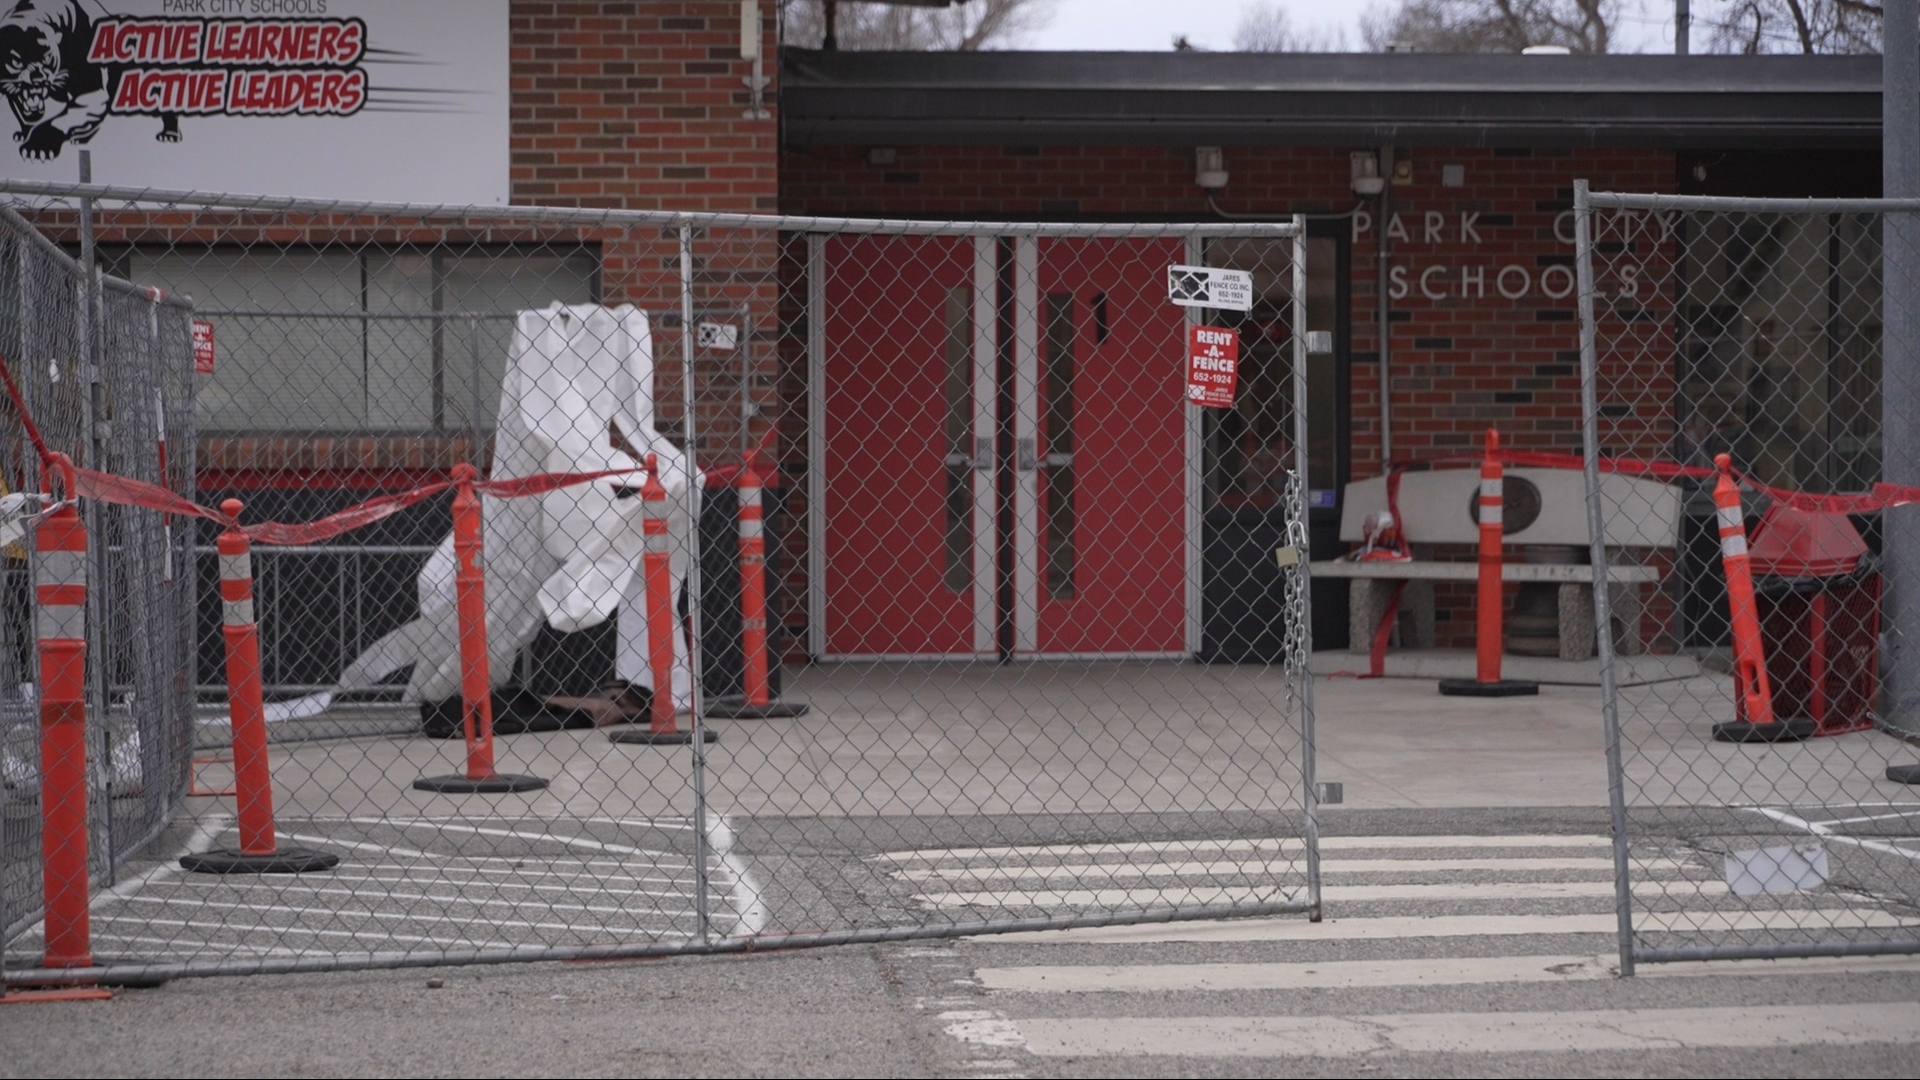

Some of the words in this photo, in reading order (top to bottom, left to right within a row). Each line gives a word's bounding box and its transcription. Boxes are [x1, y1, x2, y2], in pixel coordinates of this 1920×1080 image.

[163, 0, 206, 13] PARK
[210, 0, 245, 13] CITY
[250, 0, 328, 14] SCHOOLS
[89, 22, 202, 62] ACTIVE
[203, 22, 361, 63] LEARNERS
[113, 69, 227, 110] ACTIVE
[228, 69, 363, 112] LEADERS
[1352, 211, 1482, 244] PARK
[1553, 209, 1677, 244] CITY
[1210, 281, 1229, 290] FENCE
[1222, 274, 1241, 283] JARES
[1218, 290, 1244, 299] 652-1924
[1197, 330, 1232, 346] RENT
[1204, 345, 1224, 358] -A-
[1193, 356, 1234, 373] FENCE
[1193, 372, 1232, 384] 652-1924
